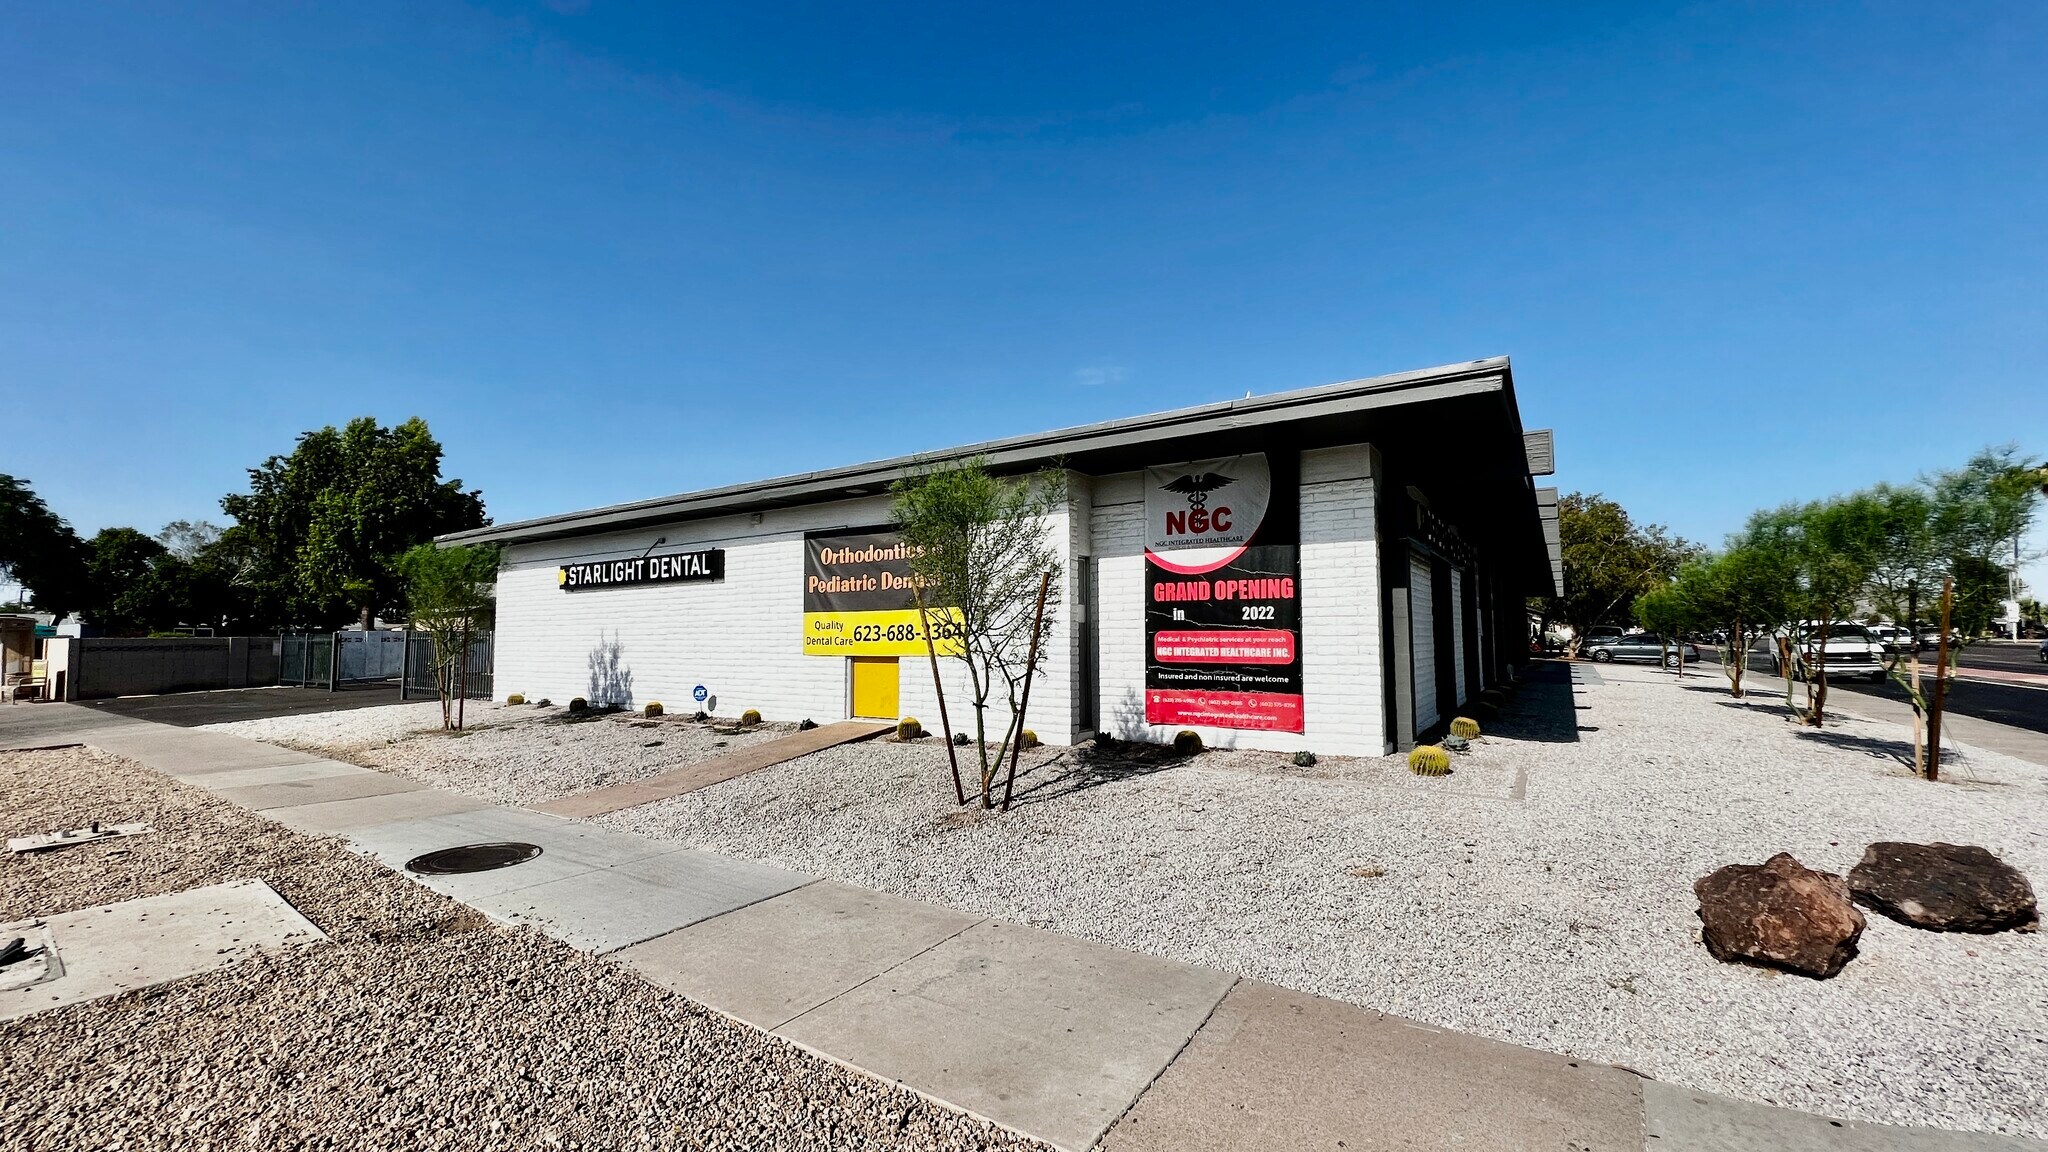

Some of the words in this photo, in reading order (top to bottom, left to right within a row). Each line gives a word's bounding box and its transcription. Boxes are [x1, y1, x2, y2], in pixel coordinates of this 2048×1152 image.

[1166, 507, 1232, 535] NGC
[1169, 538, 1204, 546] INTEGRATED
[820, 542, 926, 565] Orthodontics
[568, 560, 644, 585] STARLIGHT
[650, 553, 711, 579] DENTAL
[808, 574, 877, 594] Pediatric
[1154, 581, 1211, 602] GRAND
[1214, 577, 1294, 600] OPENING
[1173, 608, 1185, 620] in
[1242, 606, 1275, 620] 2022
[814, 620, 844, 632] Quality
[806, 636, 832, 646] Dental
[834, 635, 853, 646] Care
[1187, 636, 1219, 644] Psychiatric
[1156, 646, 1173, 657] NGC
[1173, 647, 1220, 657] INTEGRATED
[1220, 647, 1272, 658] HEALTHCARE
[1272, 648, 1291, 659] INC.
[1158, 672, 1184, 680] Insured
[1213, 674, 1240, 682] insured
[1254, 675, 1290, 683] welcome
